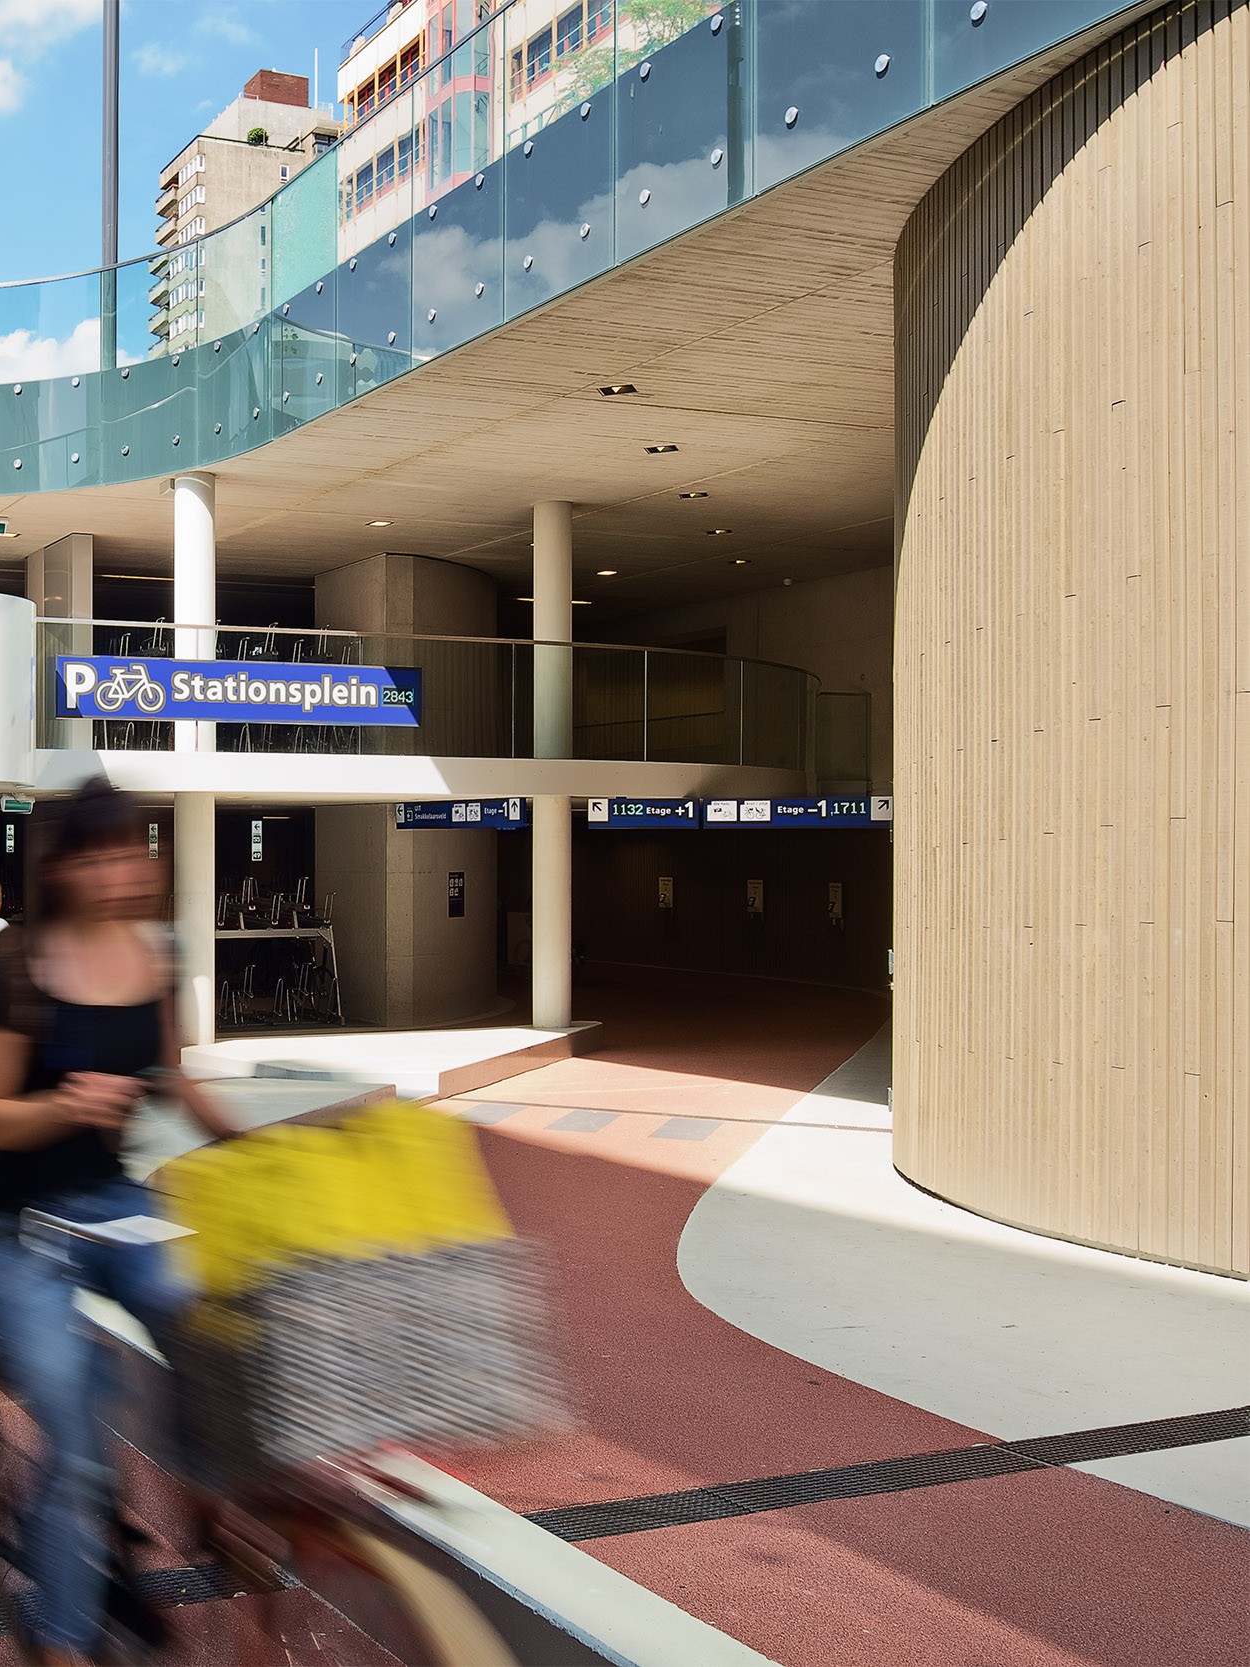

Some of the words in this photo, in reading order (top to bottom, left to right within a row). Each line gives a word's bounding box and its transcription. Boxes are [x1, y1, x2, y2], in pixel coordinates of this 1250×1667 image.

[64, 661, 95, 710] P
[172, 671, 378, 712] Stationsplein
[383, 690, 414, 703] 2843
[484, 807, 497, 816] Etage
[613, 804, 644, 815] 1132
[646, 806, 671, 816] Etage
[675, 801, 694, 818] +1
[777, 806, 804, 815] Etage
[833, 802, 866, 814] 1711
